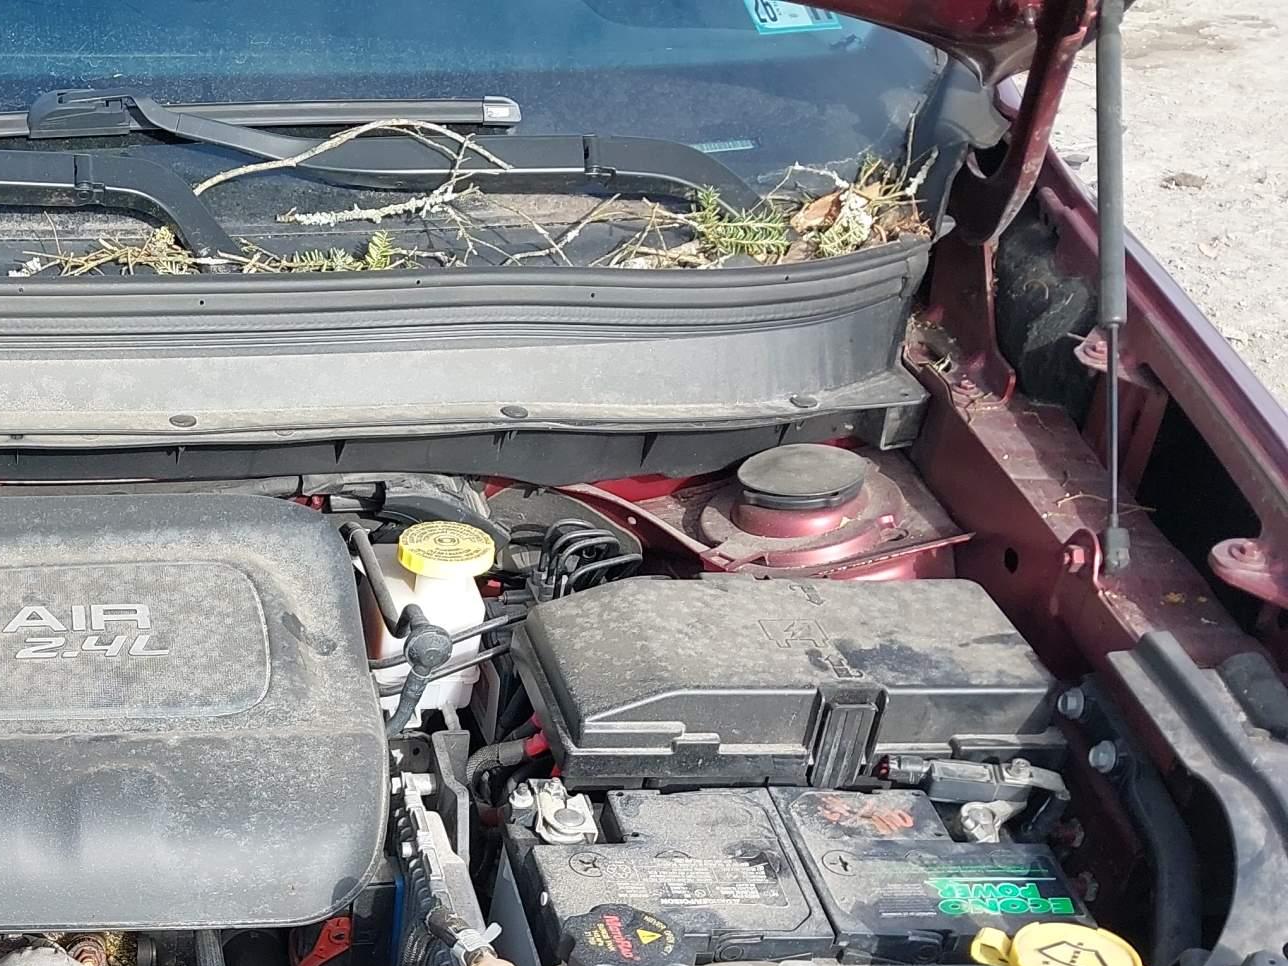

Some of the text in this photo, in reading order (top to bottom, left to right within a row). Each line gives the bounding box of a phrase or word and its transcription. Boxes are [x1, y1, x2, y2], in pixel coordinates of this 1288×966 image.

[15, 634, 170, 659] 2.4L
[934, 881, 1041, 899] POWER
[937, 897, 1076, 915] ECONO
